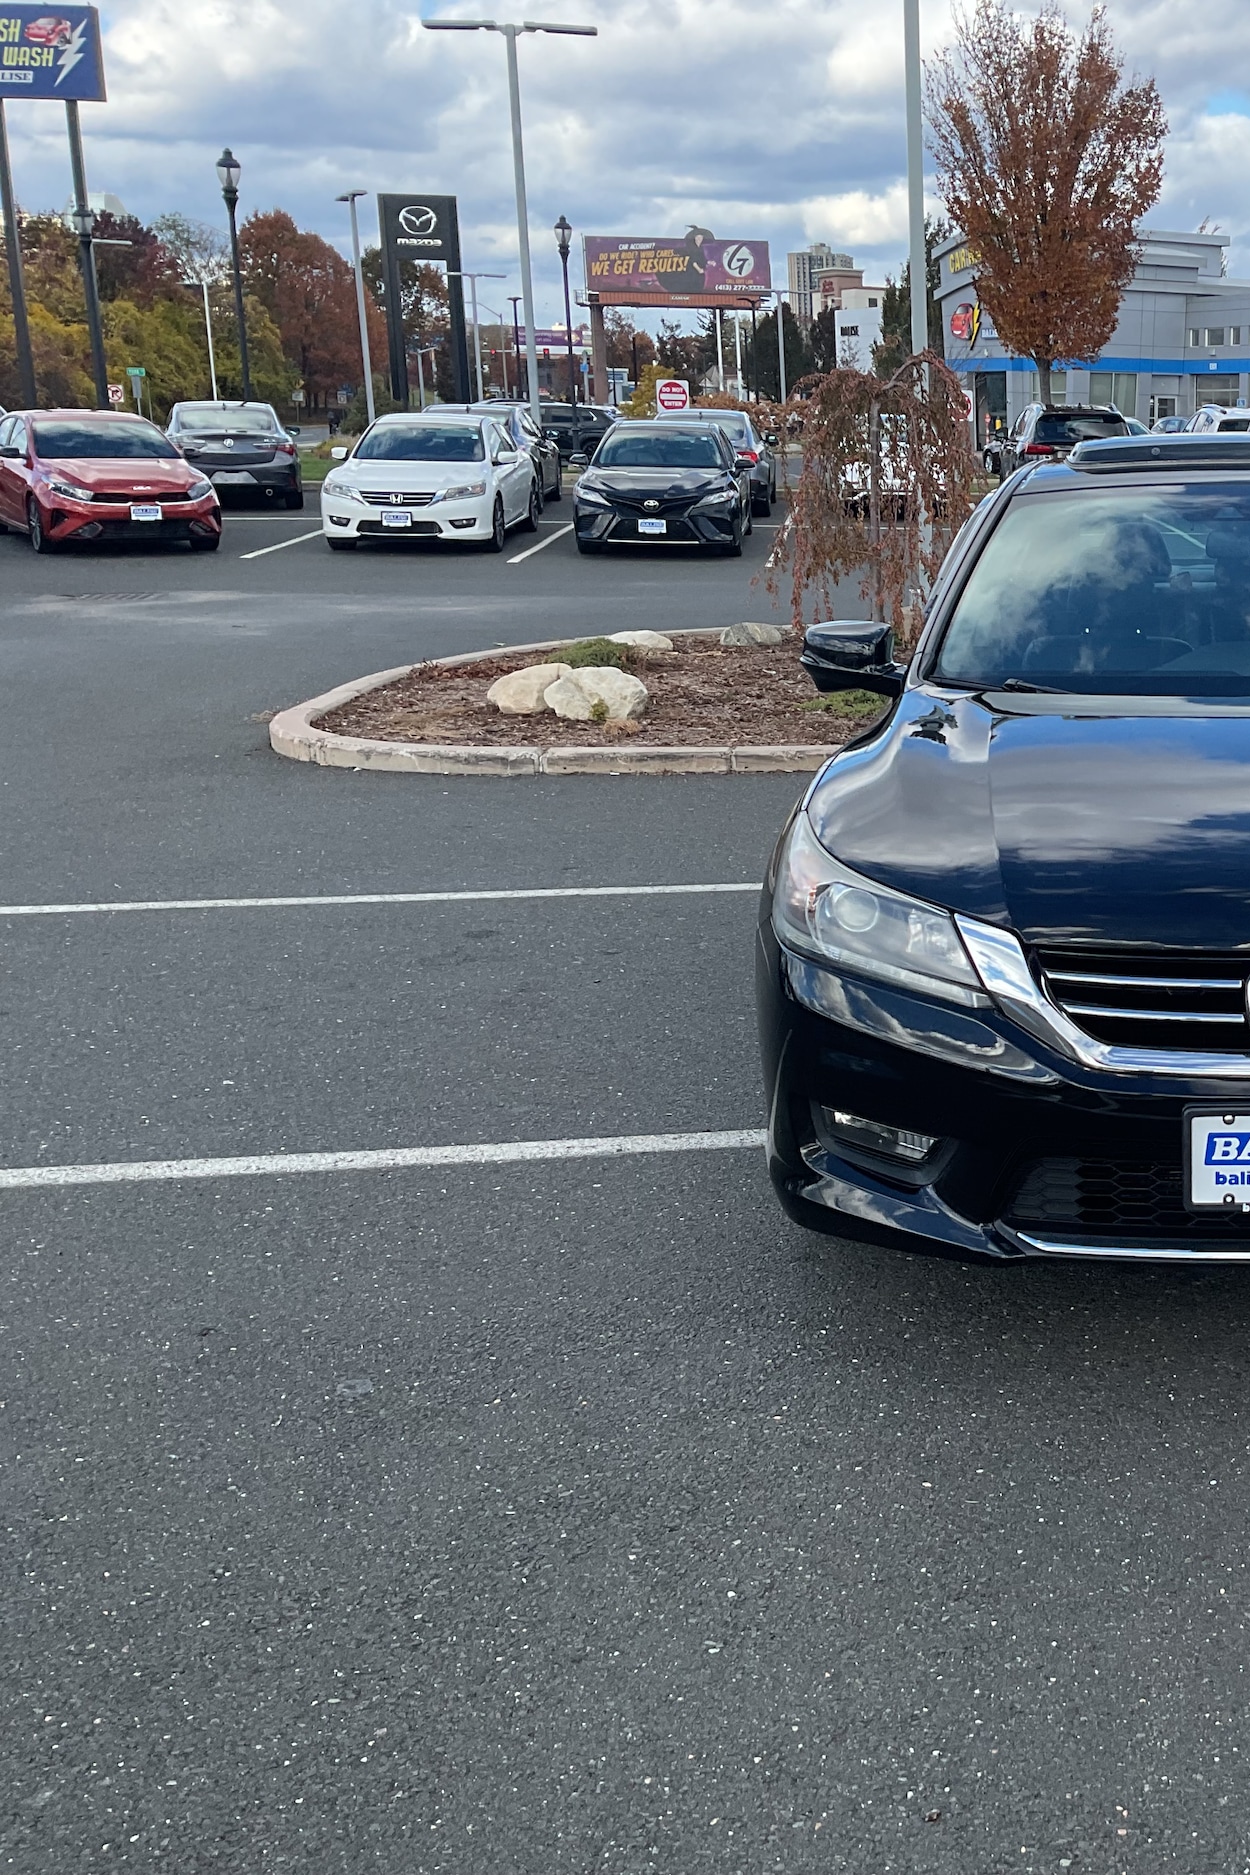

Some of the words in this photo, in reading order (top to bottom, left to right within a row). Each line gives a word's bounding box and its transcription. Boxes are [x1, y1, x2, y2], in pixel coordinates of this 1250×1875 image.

[3, 46, 54, 67] WASH
[629, 242, 656, 250] ACCIDENT?
[591, 261, 610, 276] WE
[614, 260, 635, 275] GET
[638, 256, 690, 274] RESULTS!
[949, 248, 966, 273] CAR
